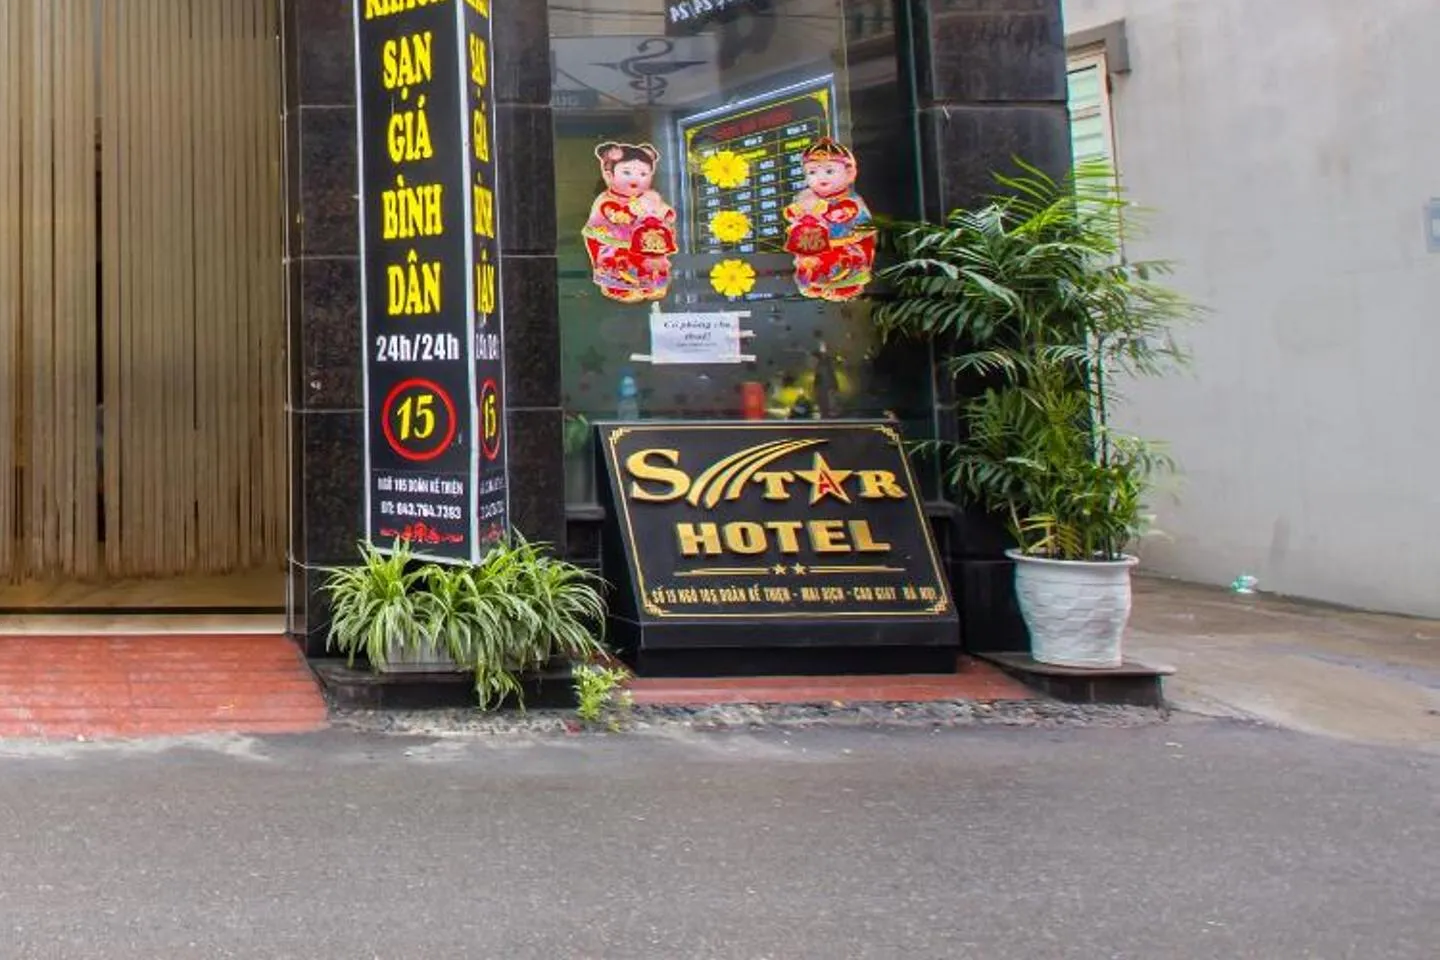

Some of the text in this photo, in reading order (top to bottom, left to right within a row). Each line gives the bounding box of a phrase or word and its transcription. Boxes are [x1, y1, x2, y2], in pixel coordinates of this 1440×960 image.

[383, 31, 432, 100] SẠN
[388, 94, 433, 162] GIÁ
[382, 174, 444, 239] BÌNH
[387, 248, 441, 315] DÂN
[376, 333, 460, 361] 24h/24h
[396, 394, 436, 441] 15
[626, 449, 908, 506] STAR
[676, 519, 891, 556] HOTEL
